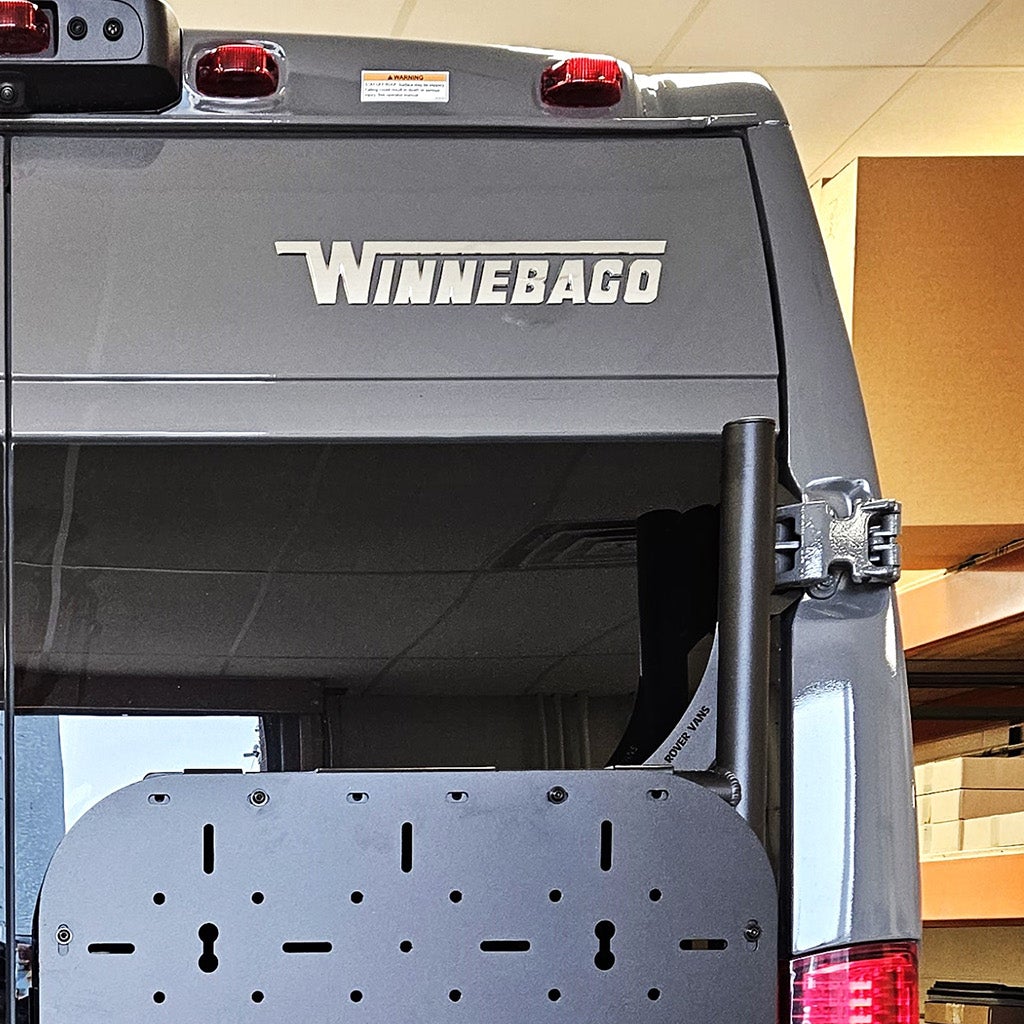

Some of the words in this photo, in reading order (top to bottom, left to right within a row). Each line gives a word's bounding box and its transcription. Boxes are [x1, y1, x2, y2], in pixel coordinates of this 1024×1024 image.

[274, 240, 667, 305] WINNEBAGO
[663, 731, 691, 764] ROVER
[687, 705, 711, 732] VANS
